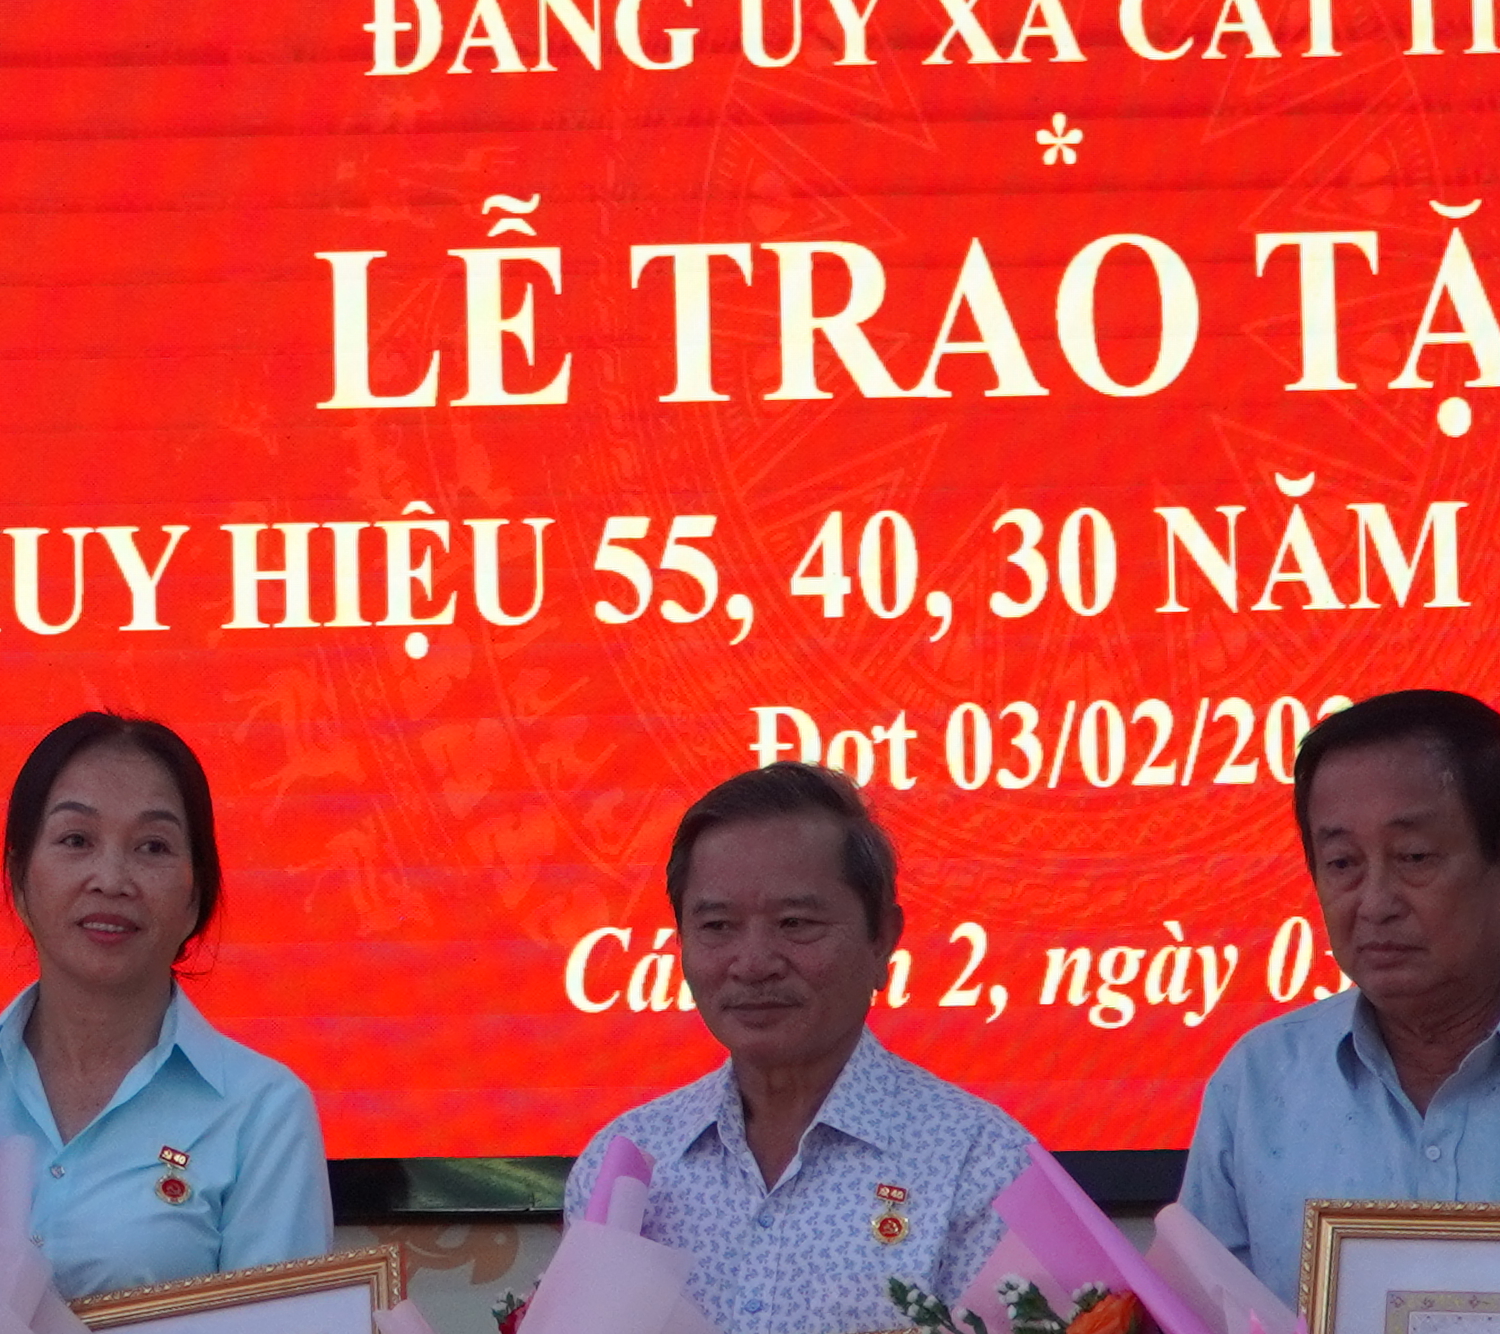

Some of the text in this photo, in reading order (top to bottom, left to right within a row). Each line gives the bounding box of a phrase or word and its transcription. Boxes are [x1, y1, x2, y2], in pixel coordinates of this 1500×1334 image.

[315, 194, 571, 409] LỄ
[631, 234, 1199, 402] TRAO
[220, 501, 554, 659] HIỆU
[594, 515, 753, 645] 55,
[791, 510, 952, 642] 40,
[990, 508, 1116, 617] 30
[1154, 472, 1471, 612] NĂM
[946, 695, 1355, 790] 03/02/20
[939, 922, 1008, 1024] 2,
[1040, 918, 1242, 1028] ngày
